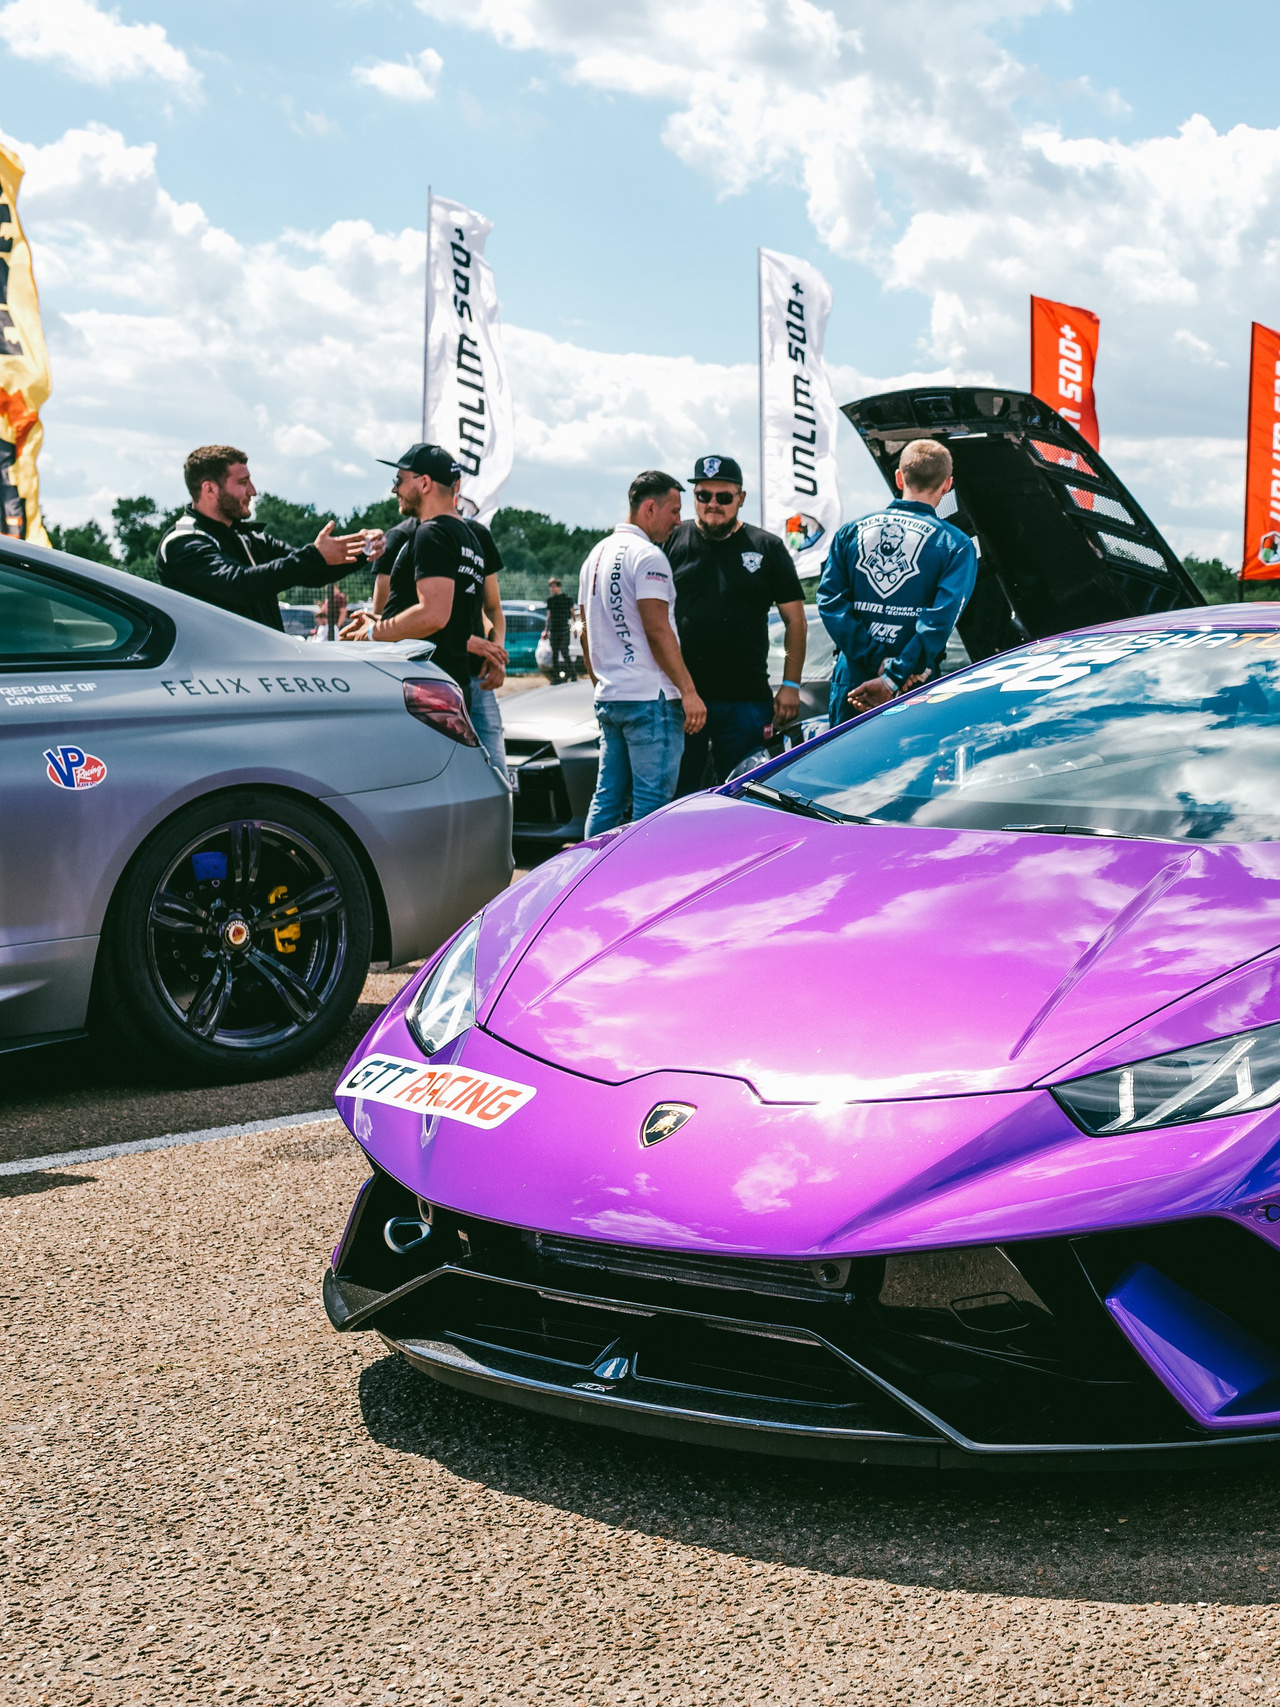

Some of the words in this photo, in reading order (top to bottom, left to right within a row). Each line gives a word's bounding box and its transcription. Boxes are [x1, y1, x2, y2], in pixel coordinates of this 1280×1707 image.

[786, 282, 807, 365] 500+
[1059, 324, 1082, 403] 500+
[457, 333, 485, 476] UNLIM
[793, 374, 817, 496] UNLIM
[609, 544, 634, 664] TURBOSYSTEMS
[0, 684, 77, 697] REPUBLIC
[76, 682, 98, 692] OF
[5, 693, 73, 706] GAMERS
[160, 678, 250, 696] FELIX
[258, 677, 350, 693] FERRO
[927, 649, 1137, 693] 86
[346, 1060, 418, 1094] GTT
[394, 1071, 523, 1121] RACING
